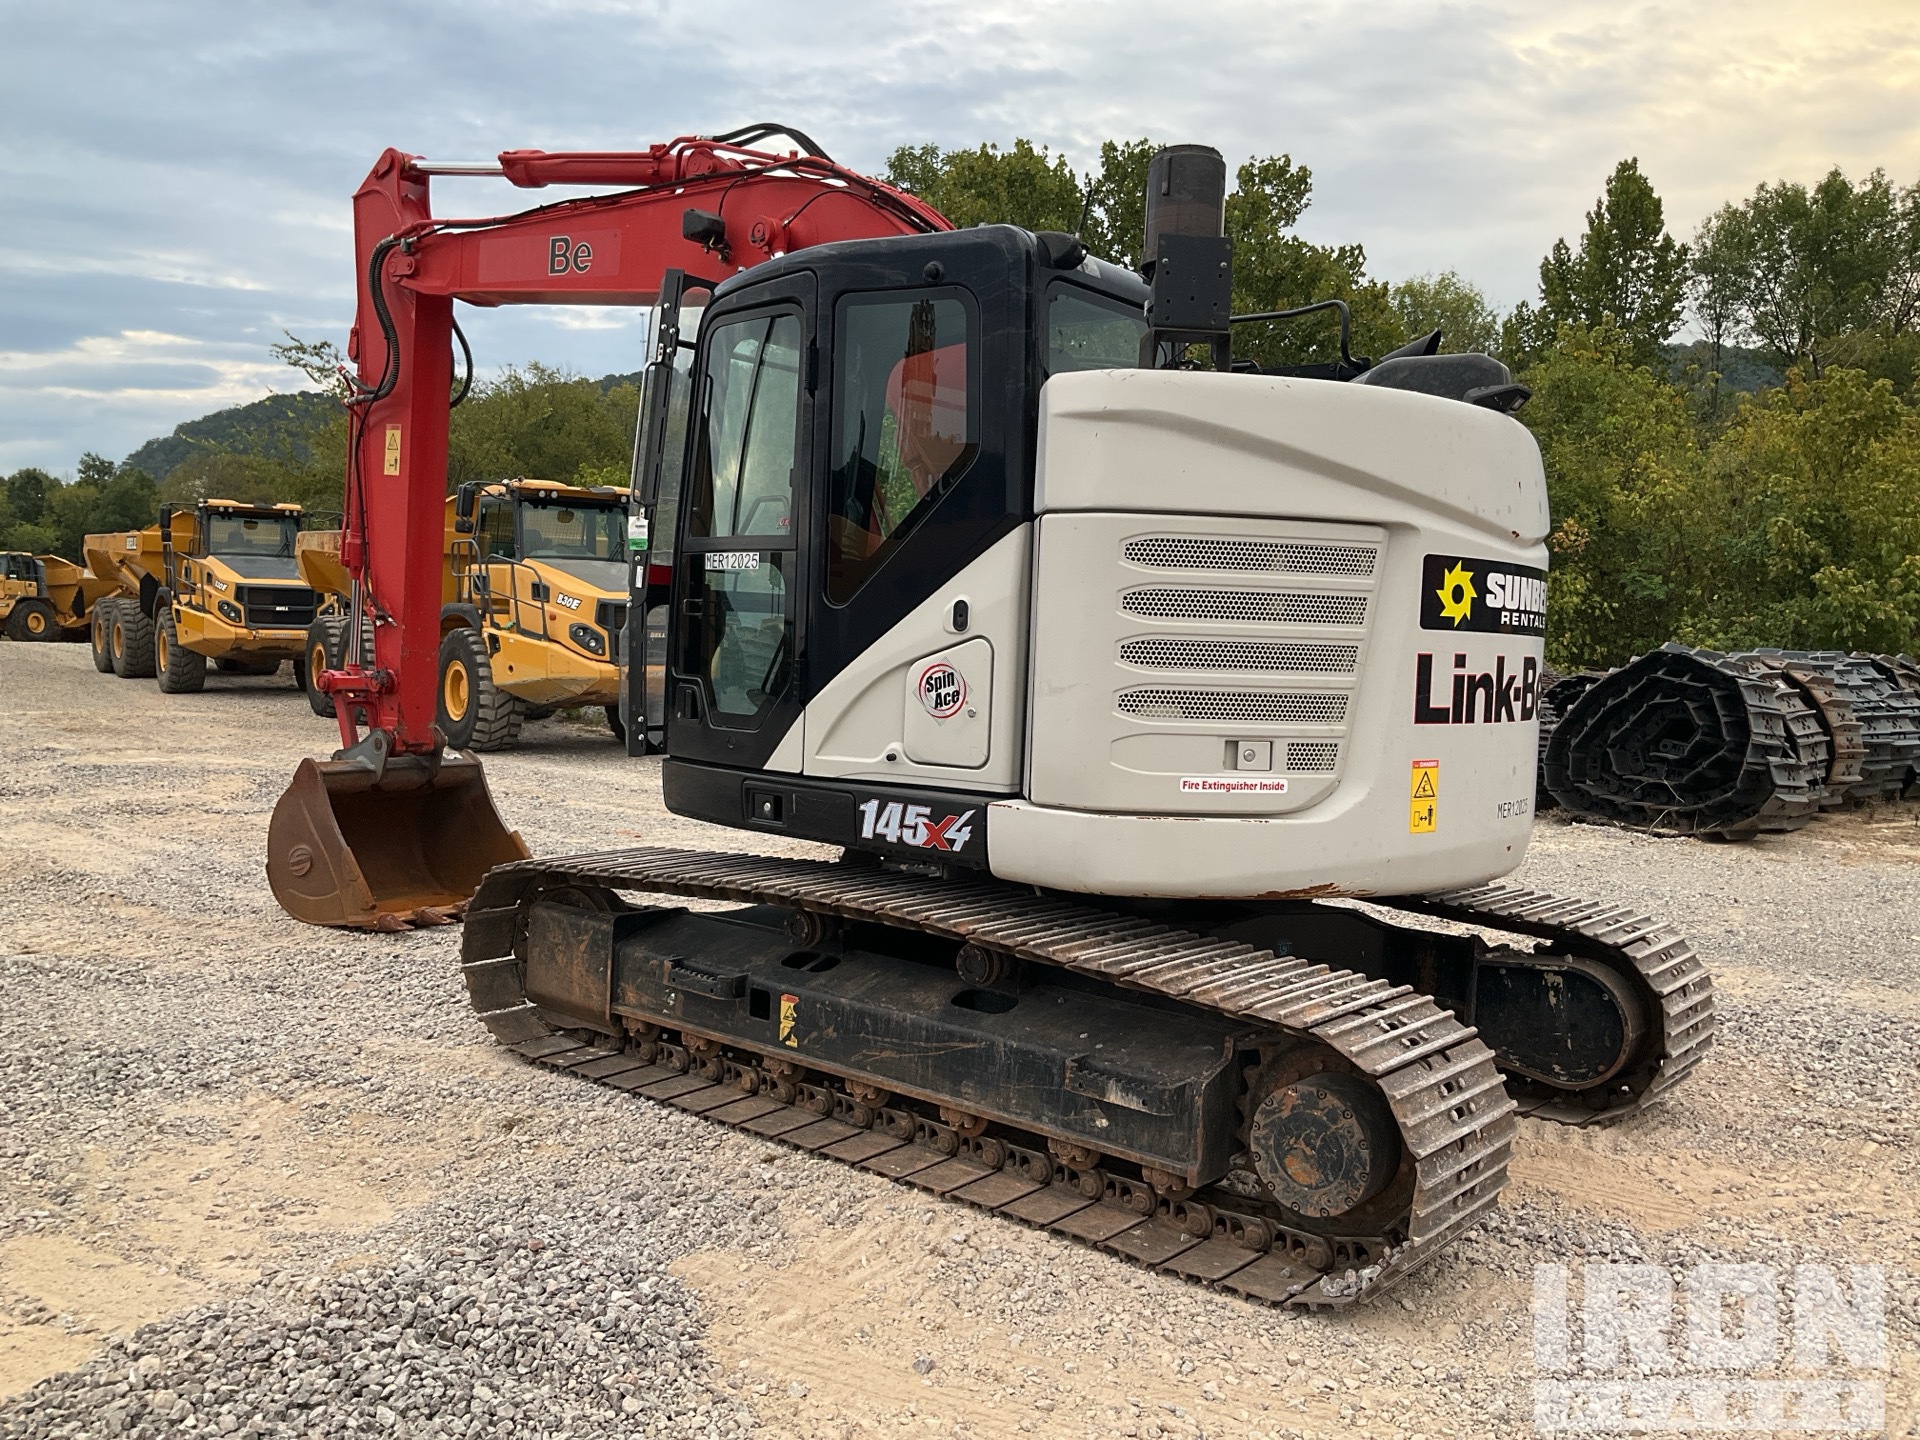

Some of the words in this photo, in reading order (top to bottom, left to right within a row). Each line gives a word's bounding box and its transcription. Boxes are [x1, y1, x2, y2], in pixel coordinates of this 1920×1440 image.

[548, 235, 593, 276] Be
[705, 552, 759, 570] MER12025
[556, 592, 582, 611] B30E
[1500, 611, 1546, 629] RENTALS
[925, 671, 955, 693] Spin
[934, 689, 960, 710] Ace
[1182, 780, 1200, 790] Fire
[1201, 781, 1258, 792] Extinguisher
[1259, 781, 1285, 791] Inside
[1497, 798, 1528, 819] MER12025
